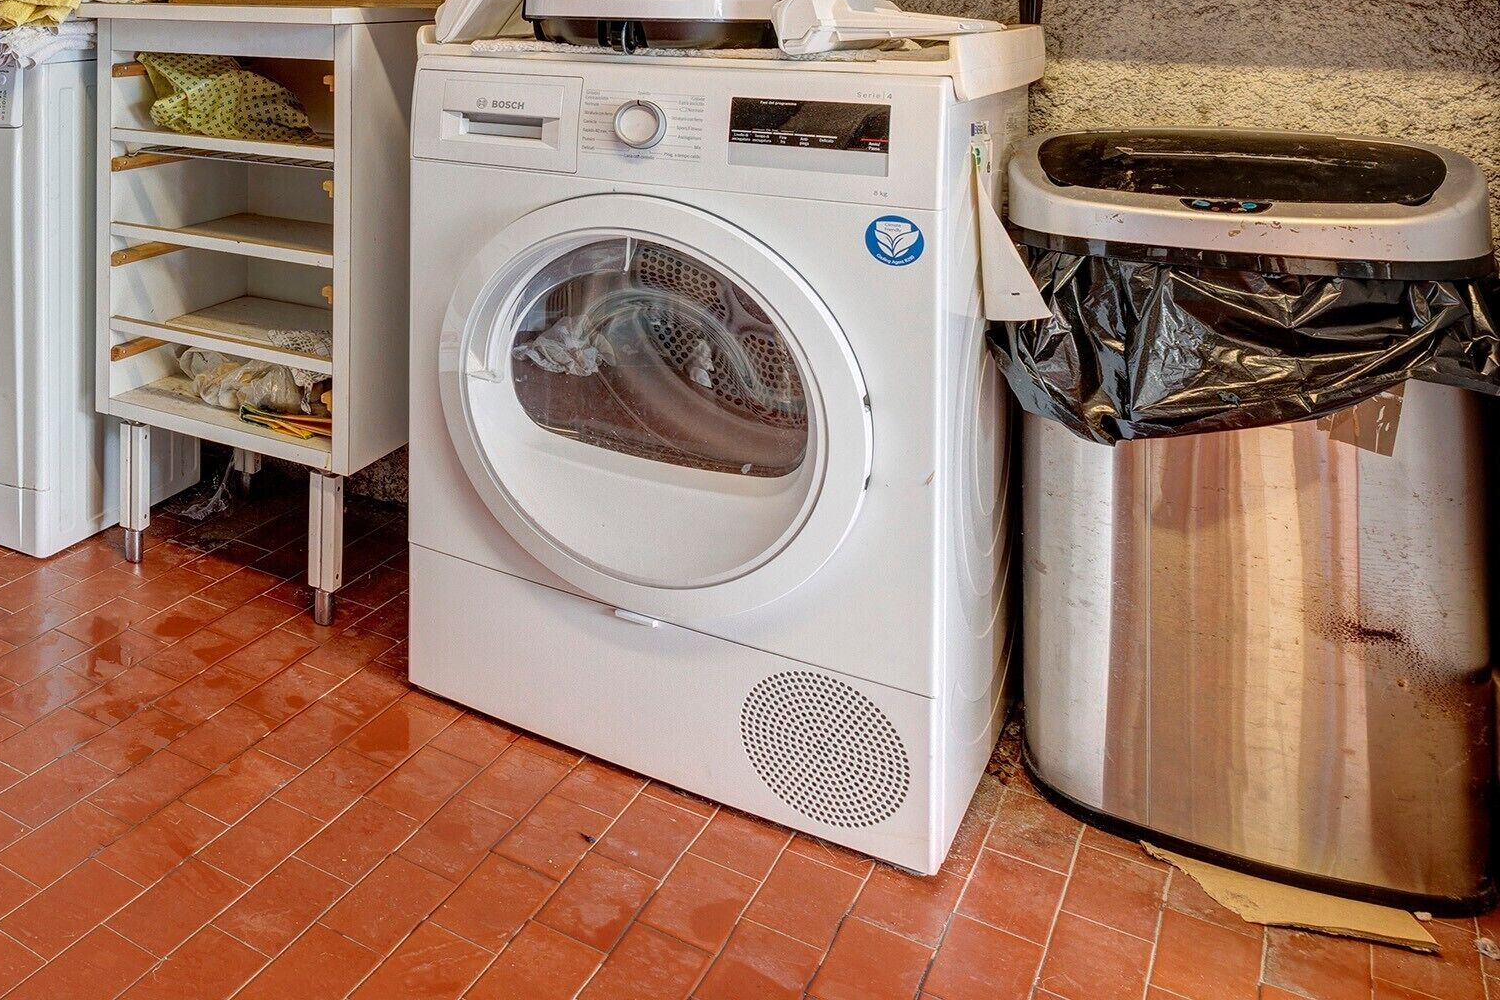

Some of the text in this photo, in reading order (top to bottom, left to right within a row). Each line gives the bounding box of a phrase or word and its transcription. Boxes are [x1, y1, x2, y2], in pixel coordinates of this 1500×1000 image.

[856, 91, 881, 99] Serie
[491, 99, 526, 110] BOSCH
[891, 258, 905, 267] Agent
